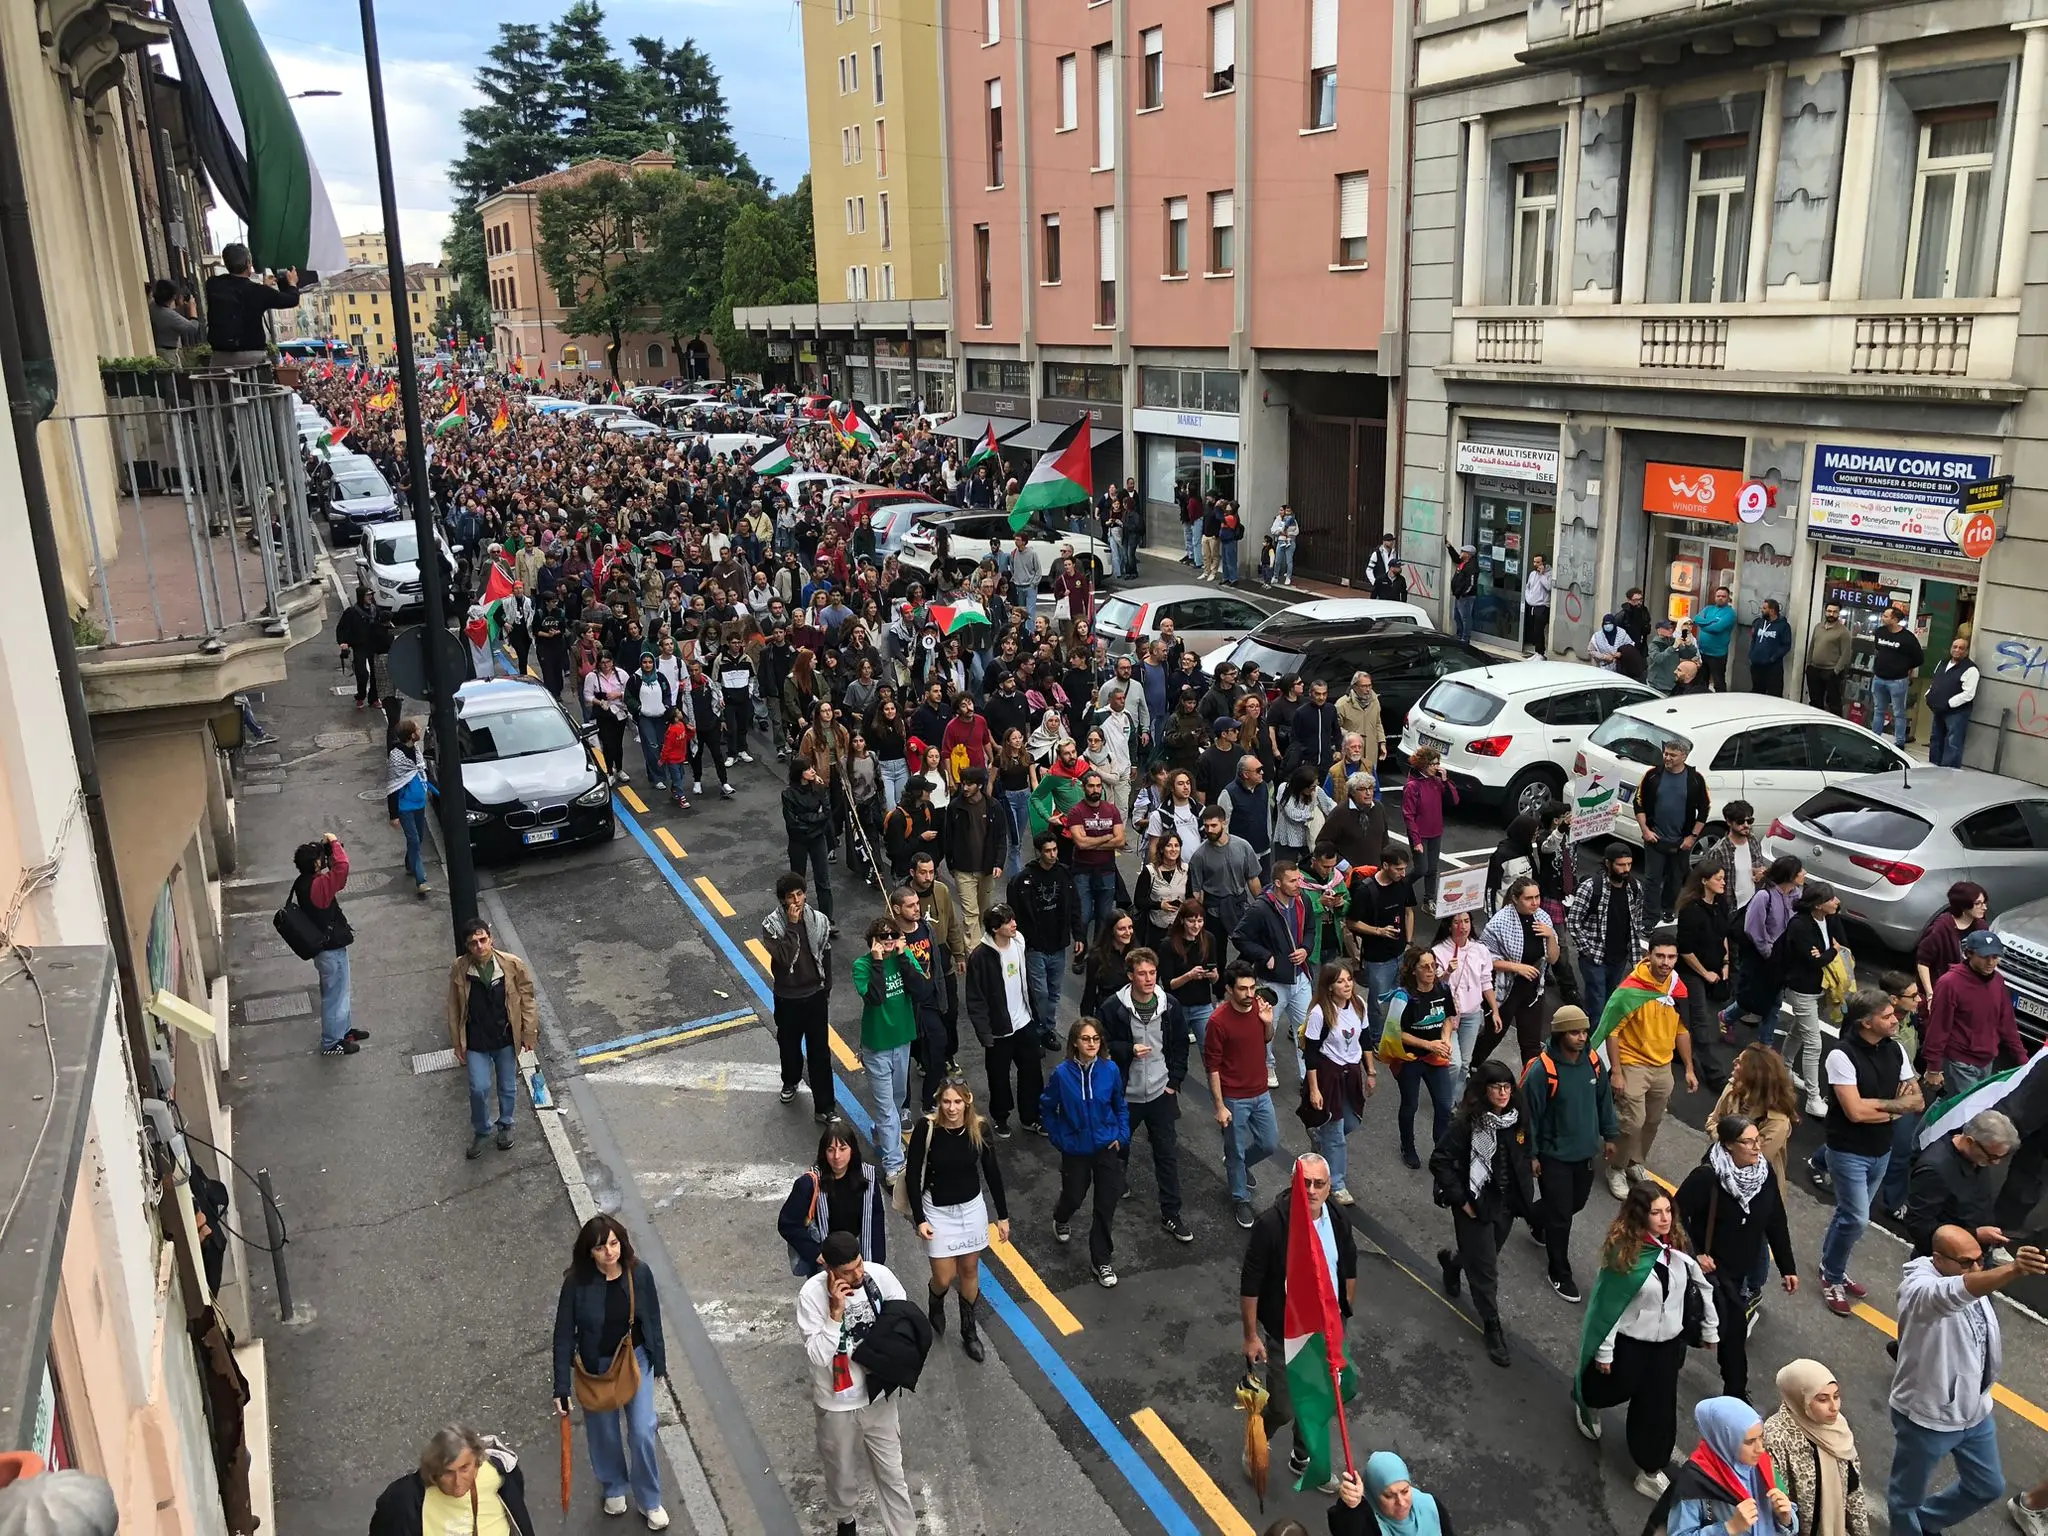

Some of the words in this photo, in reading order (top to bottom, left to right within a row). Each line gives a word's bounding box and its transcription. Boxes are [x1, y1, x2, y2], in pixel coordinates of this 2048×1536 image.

[1177, 414, 1203, 427] MARKET
[1461, 445, 1495, 455] AGENZIA
[1496, 448, 1555, 462] MULTISERVIZI
[1460, 463, 1474, 472] 730
[1522, 461, 1541, 471] وكالة
[1824, 452, 1897, 473] MADHAV
[1898, 458, 1941, 477] COM
[1942, 461, 1977, 480] SRL
[1535, 472, 1554, 482] ISEE
[1839, 474, 1864, 483] MONEY
[1864, 477, 1900, 487] TRANSFER
[1907, 480, 1937, 490] SCHEDE
[1937, 483, 1952, 492] SIM
[1969, 484, 1999, 495] WESTERN
[1853, 488, 1876, 497] VENDITA
[1876, 490, 1881, 498] E
[1881, 491, 1914, 501] ACCESSORI
[1914, 494, 1926, 502] PER
[1926, 495, 1945, 504] TUTTE
[1945, 497, 1952, 505] LE
[1672, 501, 1708, 513] WINDTRE
[1820, 498, 1834, 508] TIM
[1827, 517, 1843, 525] Union
[1828, 511, 1849, 520] Western
[1862, 515, 1901, 527] MoneyGram
[1901, 518, 1922, 534] ria
[1967, 520, 1993, 543] ria
[1832, 588, 1862, 603] FREE
[1866, 594, 1889, 607] SIM
